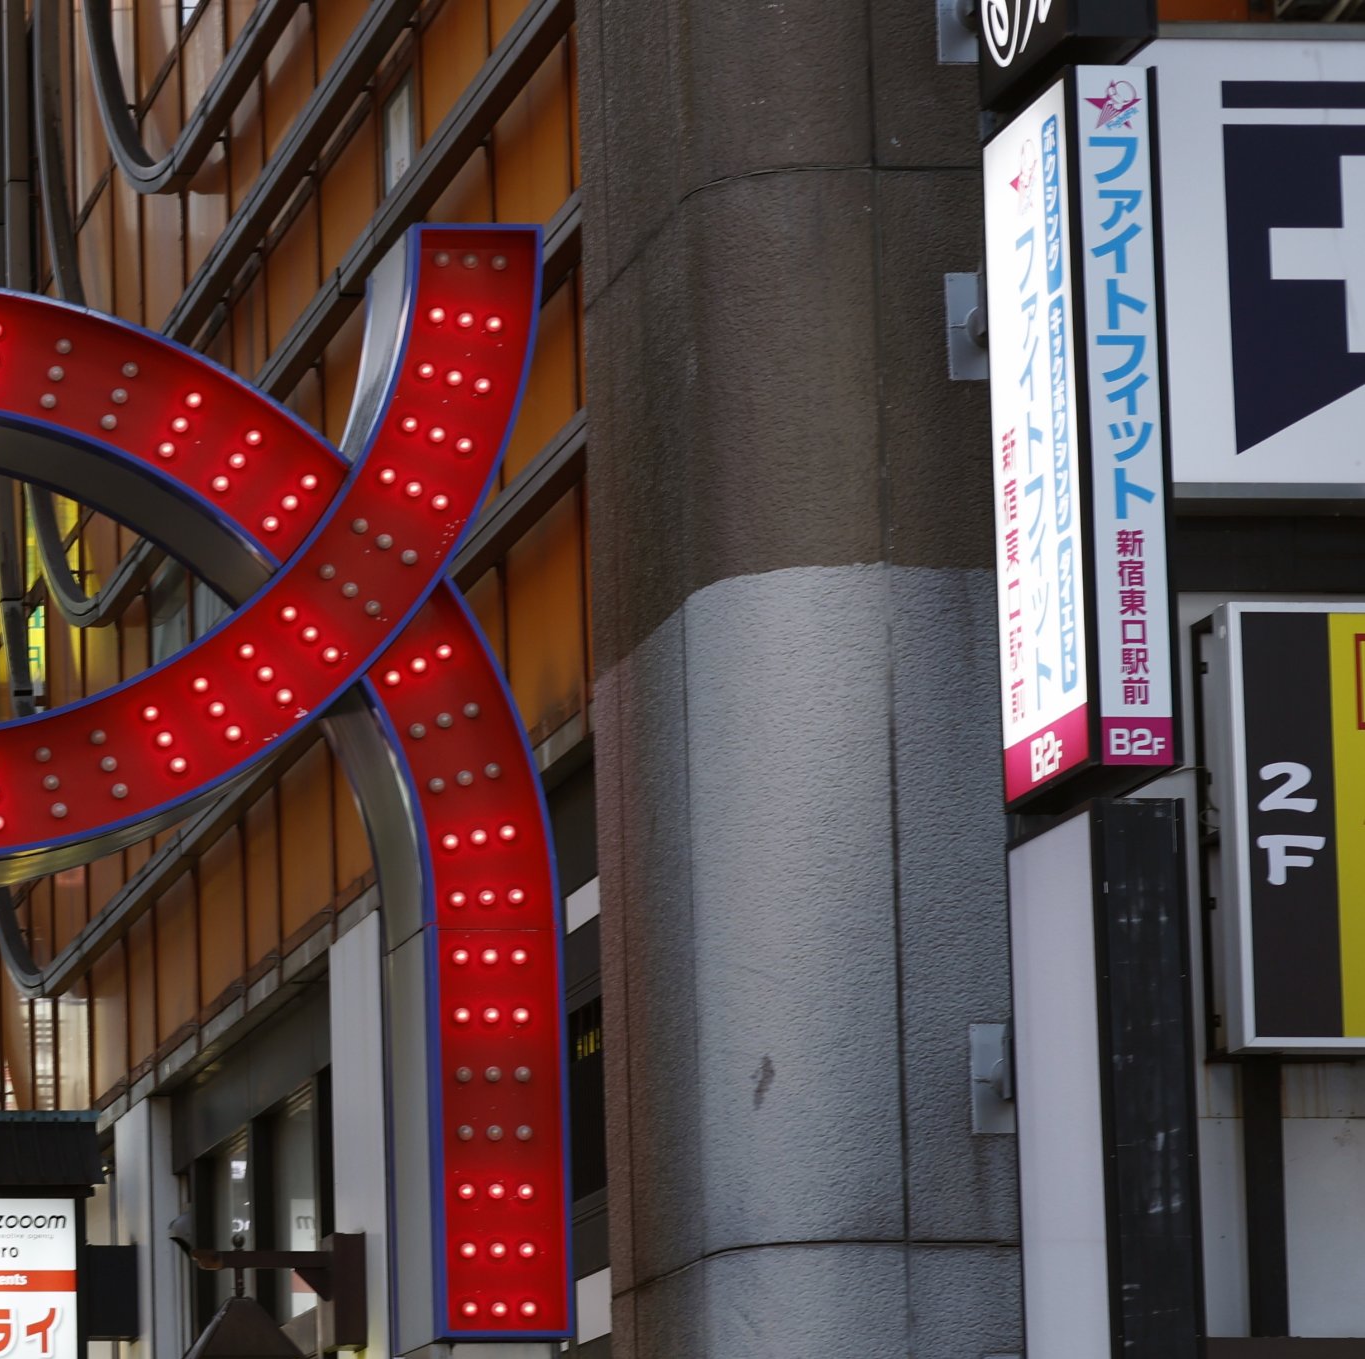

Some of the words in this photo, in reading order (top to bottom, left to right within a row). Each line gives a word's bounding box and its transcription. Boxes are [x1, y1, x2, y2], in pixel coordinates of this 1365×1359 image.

[1042, 118, 1060, 272] ボクシング
[1088, 136, 1157, 519] ファイトフィット
[1015, 224, 1053, 712] ファイトフィット
[1049, 307, 1071, 528] キックボクシング
[1058, 557, 1077, 690] ダイエット
[1115, 530, 1150, 705] 新宿東口駅前
[1030, 730, 1063, 783] B2F
[1108, 728, 1166, 757] B2F
[1257, 761, 1327, 887] 2F
